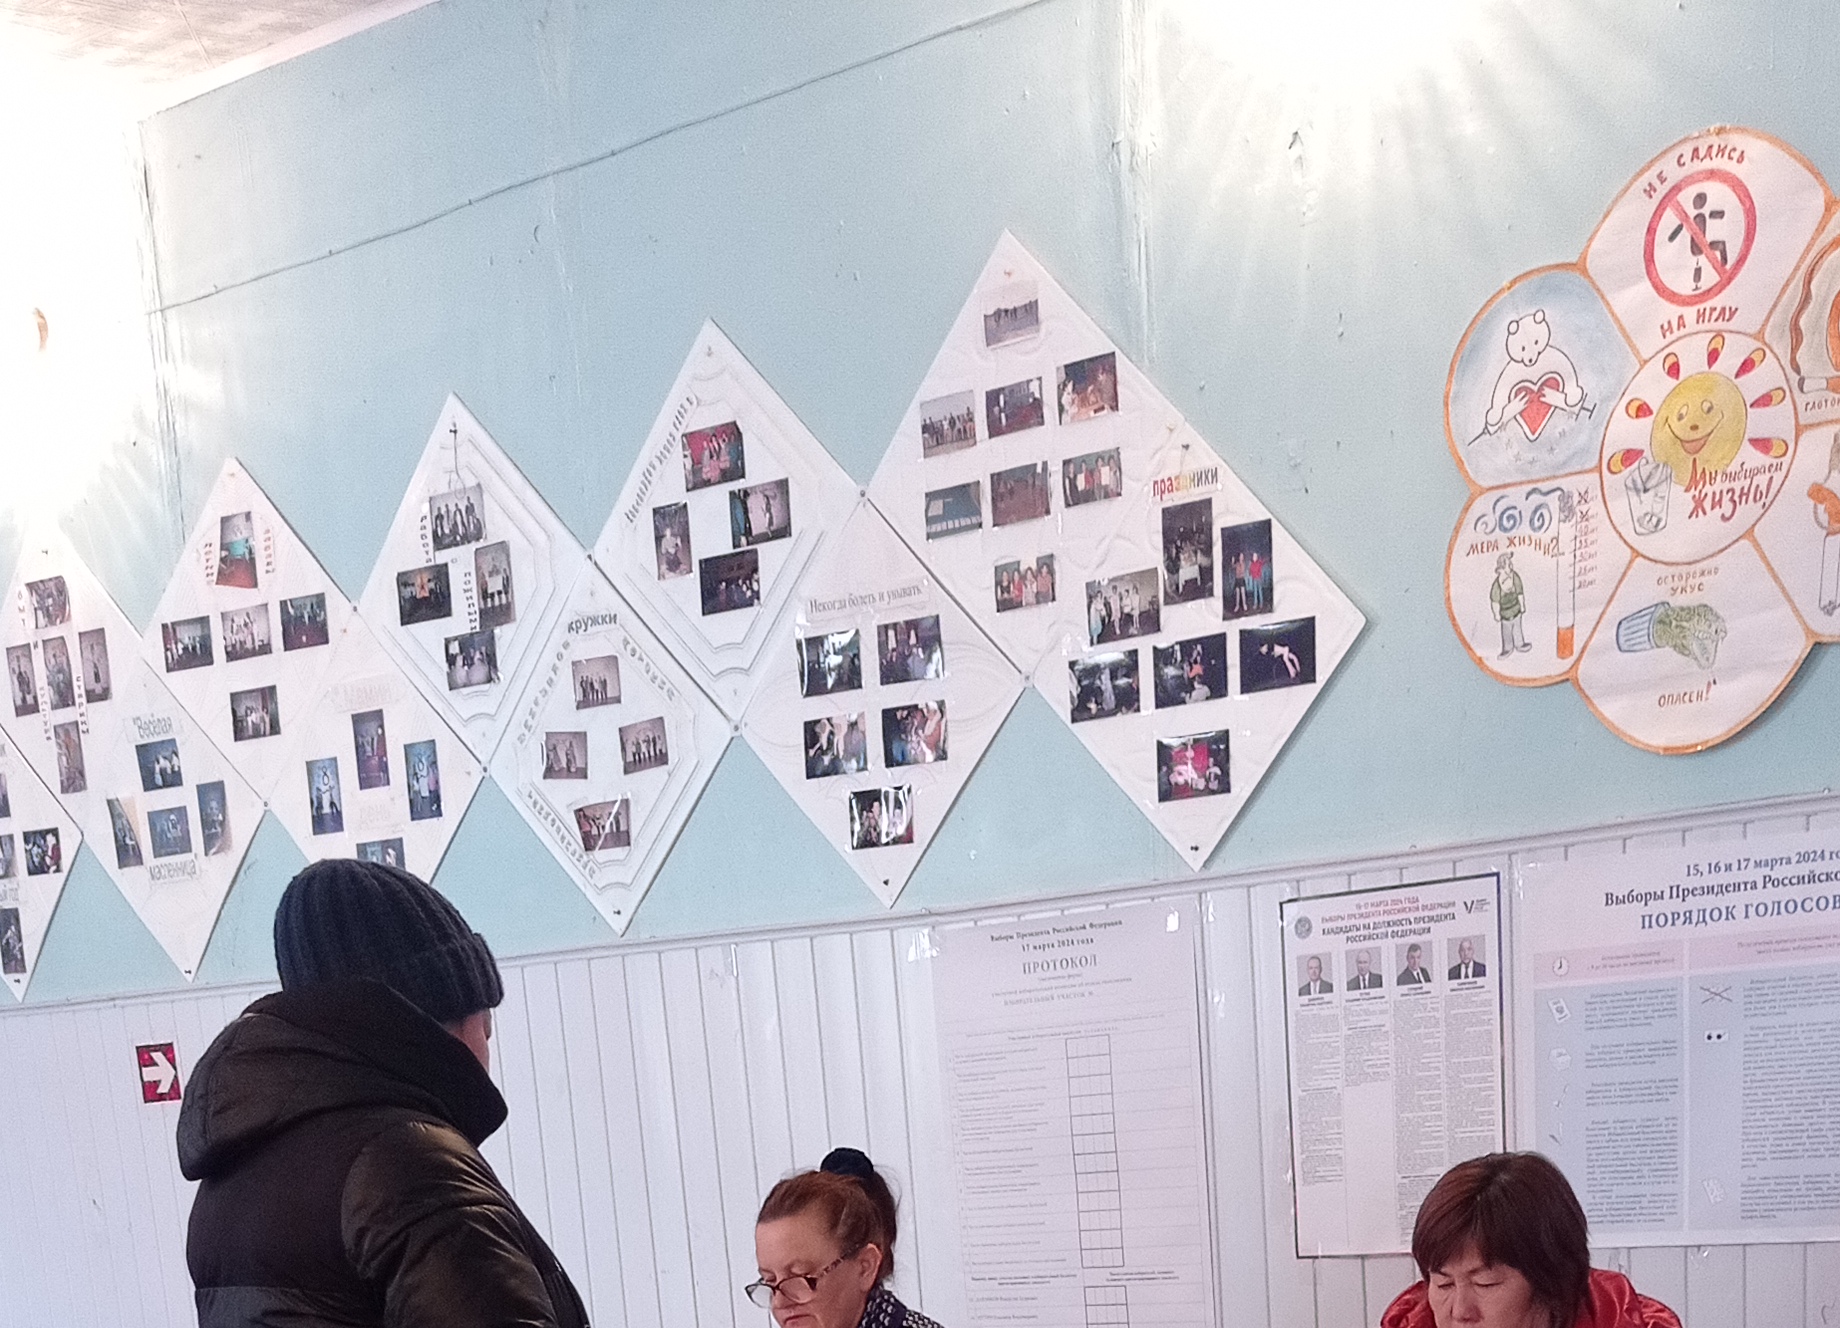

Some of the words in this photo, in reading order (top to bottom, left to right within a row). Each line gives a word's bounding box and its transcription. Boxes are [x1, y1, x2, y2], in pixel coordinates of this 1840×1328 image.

[1643, 170, 1667, 199] НЕ
[1677, 144, 1745, 167] САДИСЬ
[1660, 314, 1686, 339] НА
[1696, 305, 1739, 325] ИГЛУ
[1152, 466, 1219, 501] праздники
[1466, 539, 1499, 557] МЕРА
[567, 612, 618, 634] кружки
[1686, 863, 1704, 878] 15,
[1707, 860, 1721, 874] 16
[1723, 863, 1733, 873] и
[1737, 858, 1751, 871] 17
[1753, 855, 1792, 871] марта
[1795, 848, 1826, 864] 2024
[1604, 888, 1665, 907] Выборы
[1668, 877, 1758, 902] Президента
[1640, 904, 1737, 930] ПОРЯДОК
[1022, 954, 1098, 975] ПРОТОКОЛ
